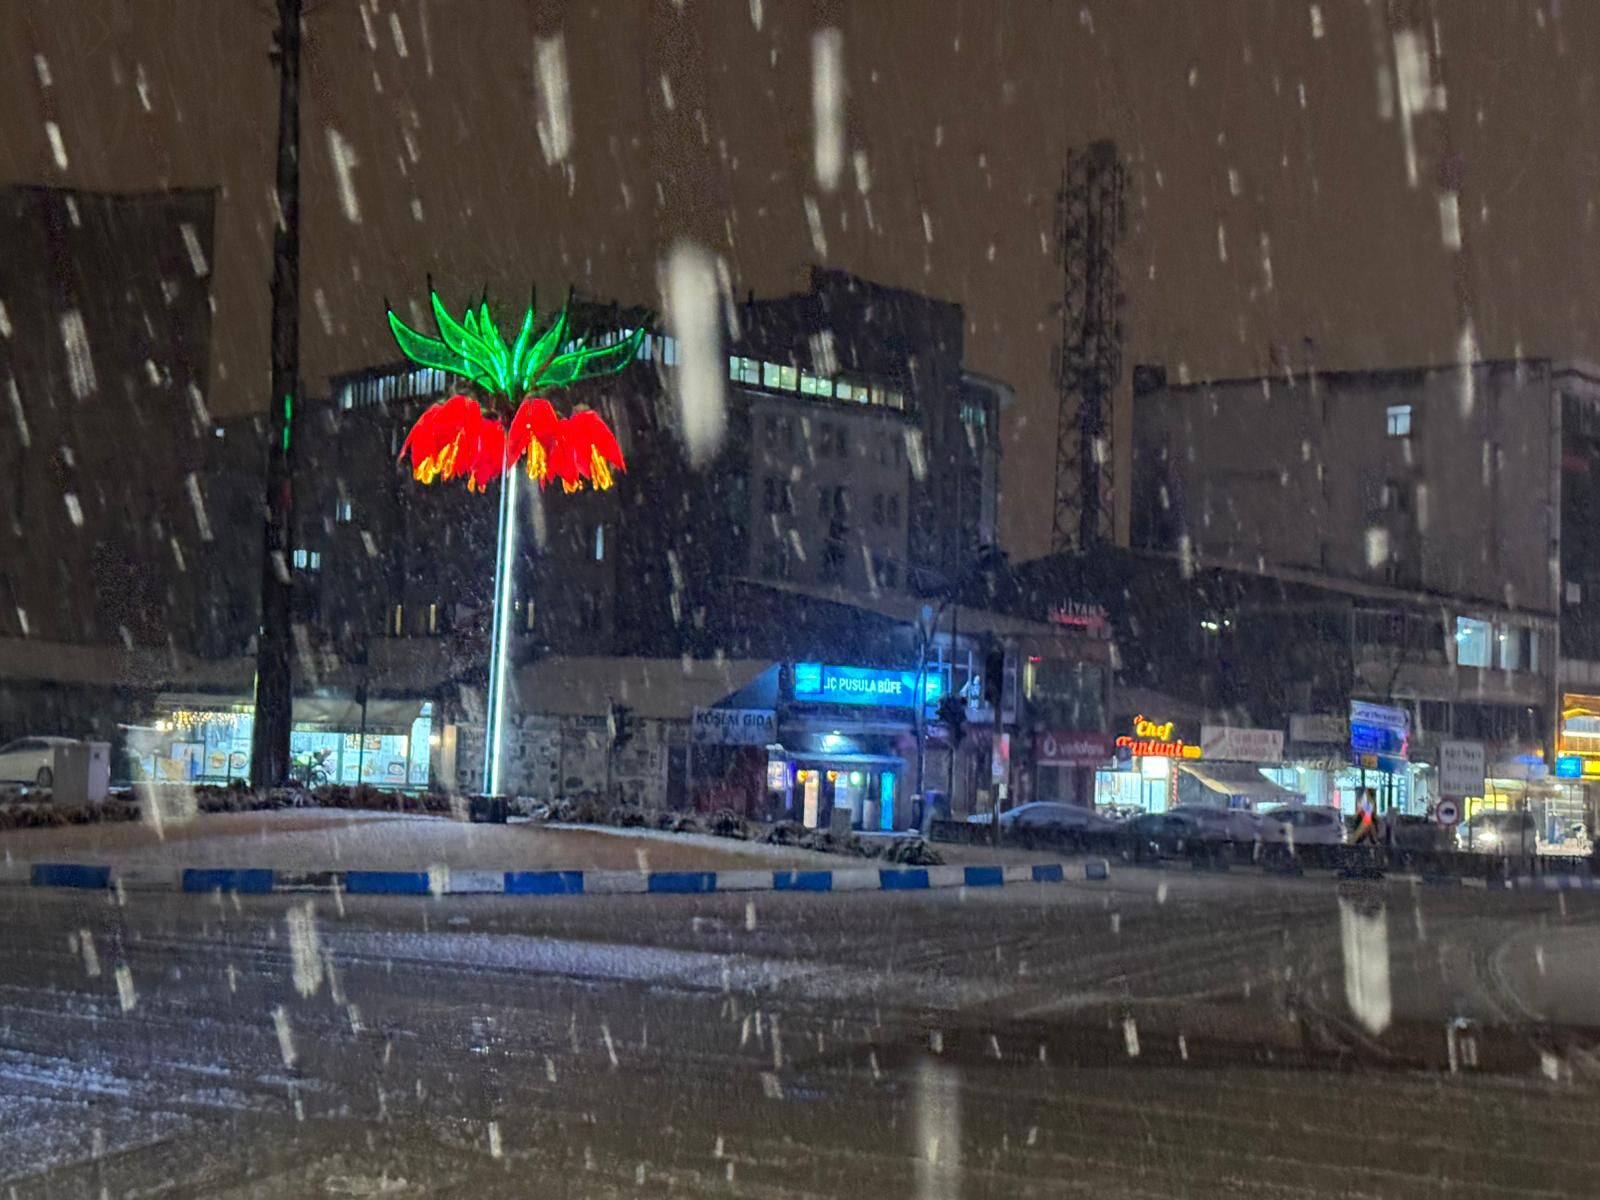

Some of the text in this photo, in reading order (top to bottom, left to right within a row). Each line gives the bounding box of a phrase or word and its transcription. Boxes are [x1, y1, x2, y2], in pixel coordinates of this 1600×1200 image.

[839, 677, 876, 693] PUSULA
[743, 712, 773, 729] GIDA
[1135, 719, 1174, 741] Chef
